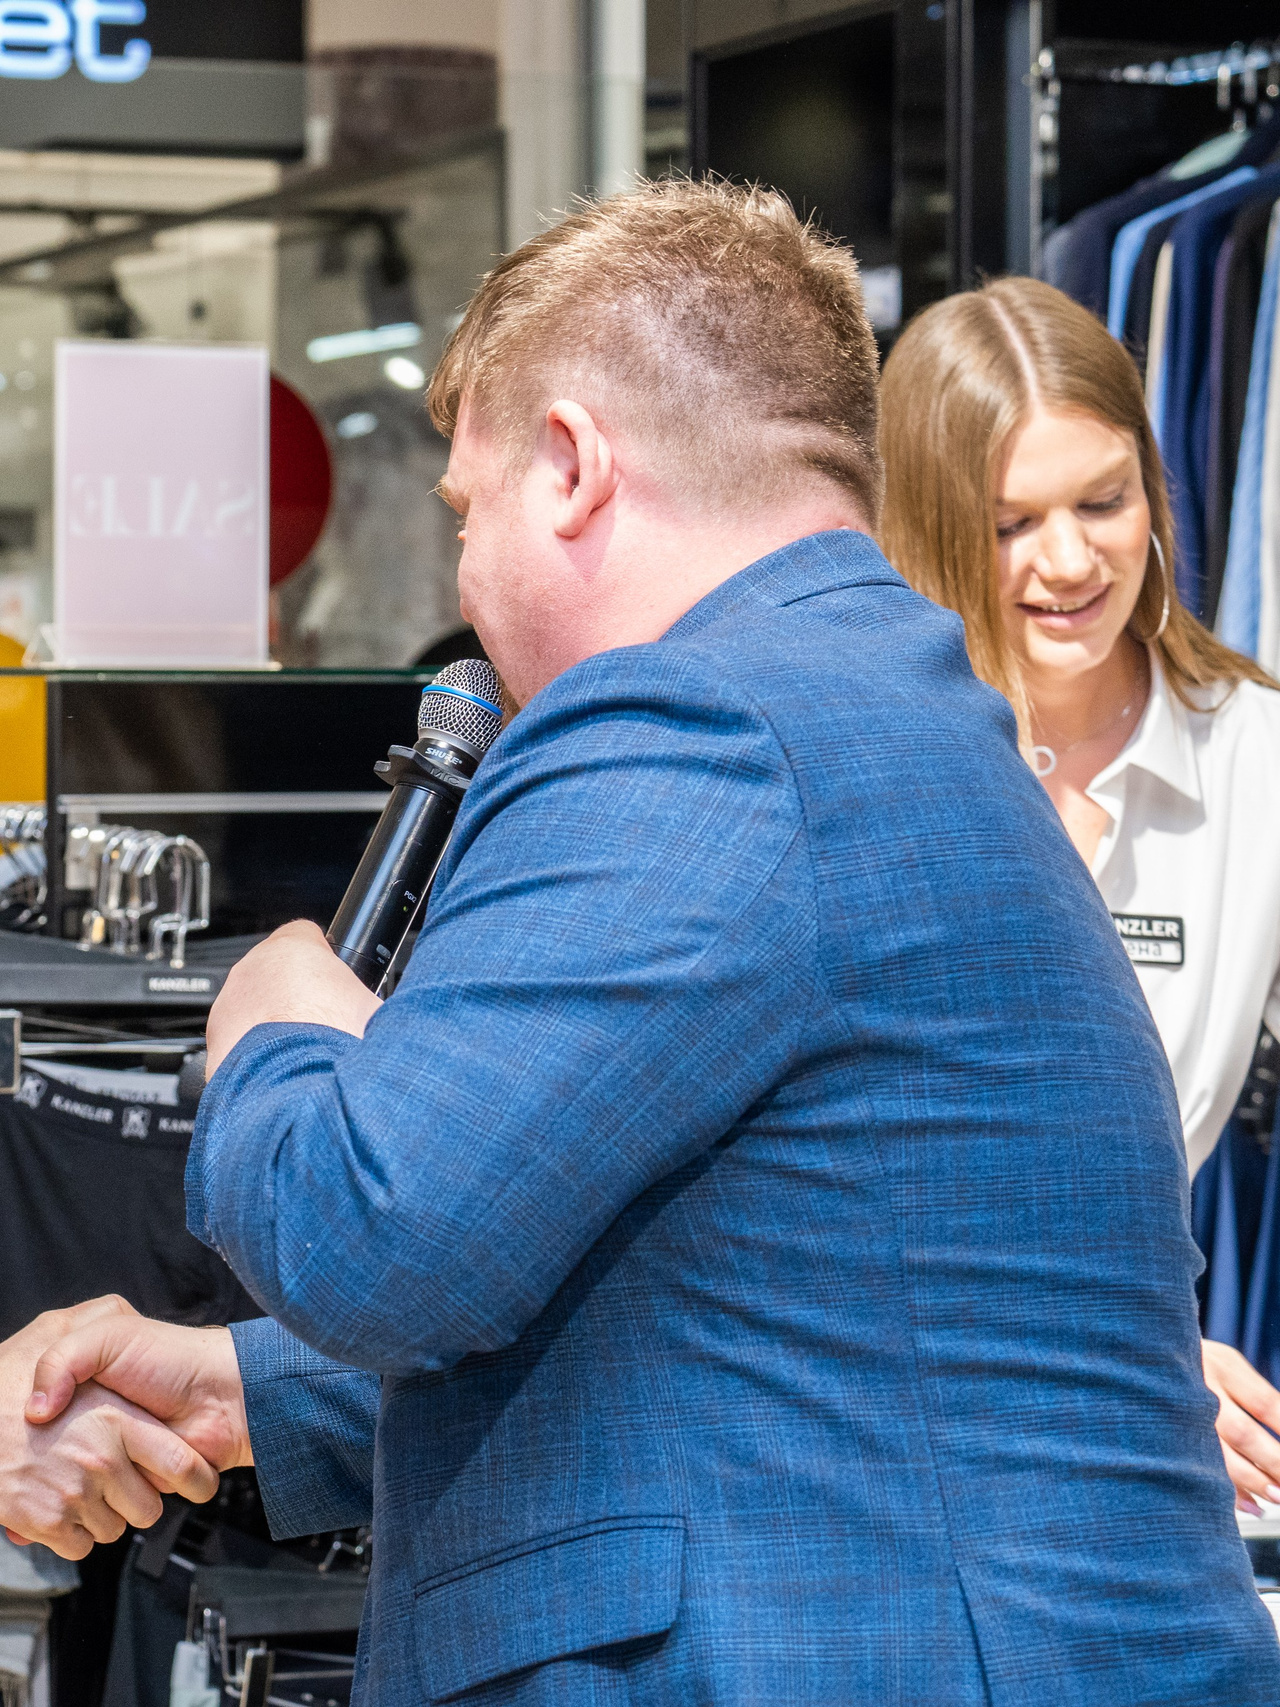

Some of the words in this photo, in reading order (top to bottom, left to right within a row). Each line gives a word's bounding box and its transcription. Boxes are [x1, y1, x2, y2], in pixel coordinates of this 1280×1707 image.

[425, 747, 460, 765] SHURE
[1114, 918, 1179, 938] NZLER
[149, 977, 211, 992] KANZLER
[51, 1094, 115, 1124] KANZLER
[158, 1117, 195, 1133] KAN
